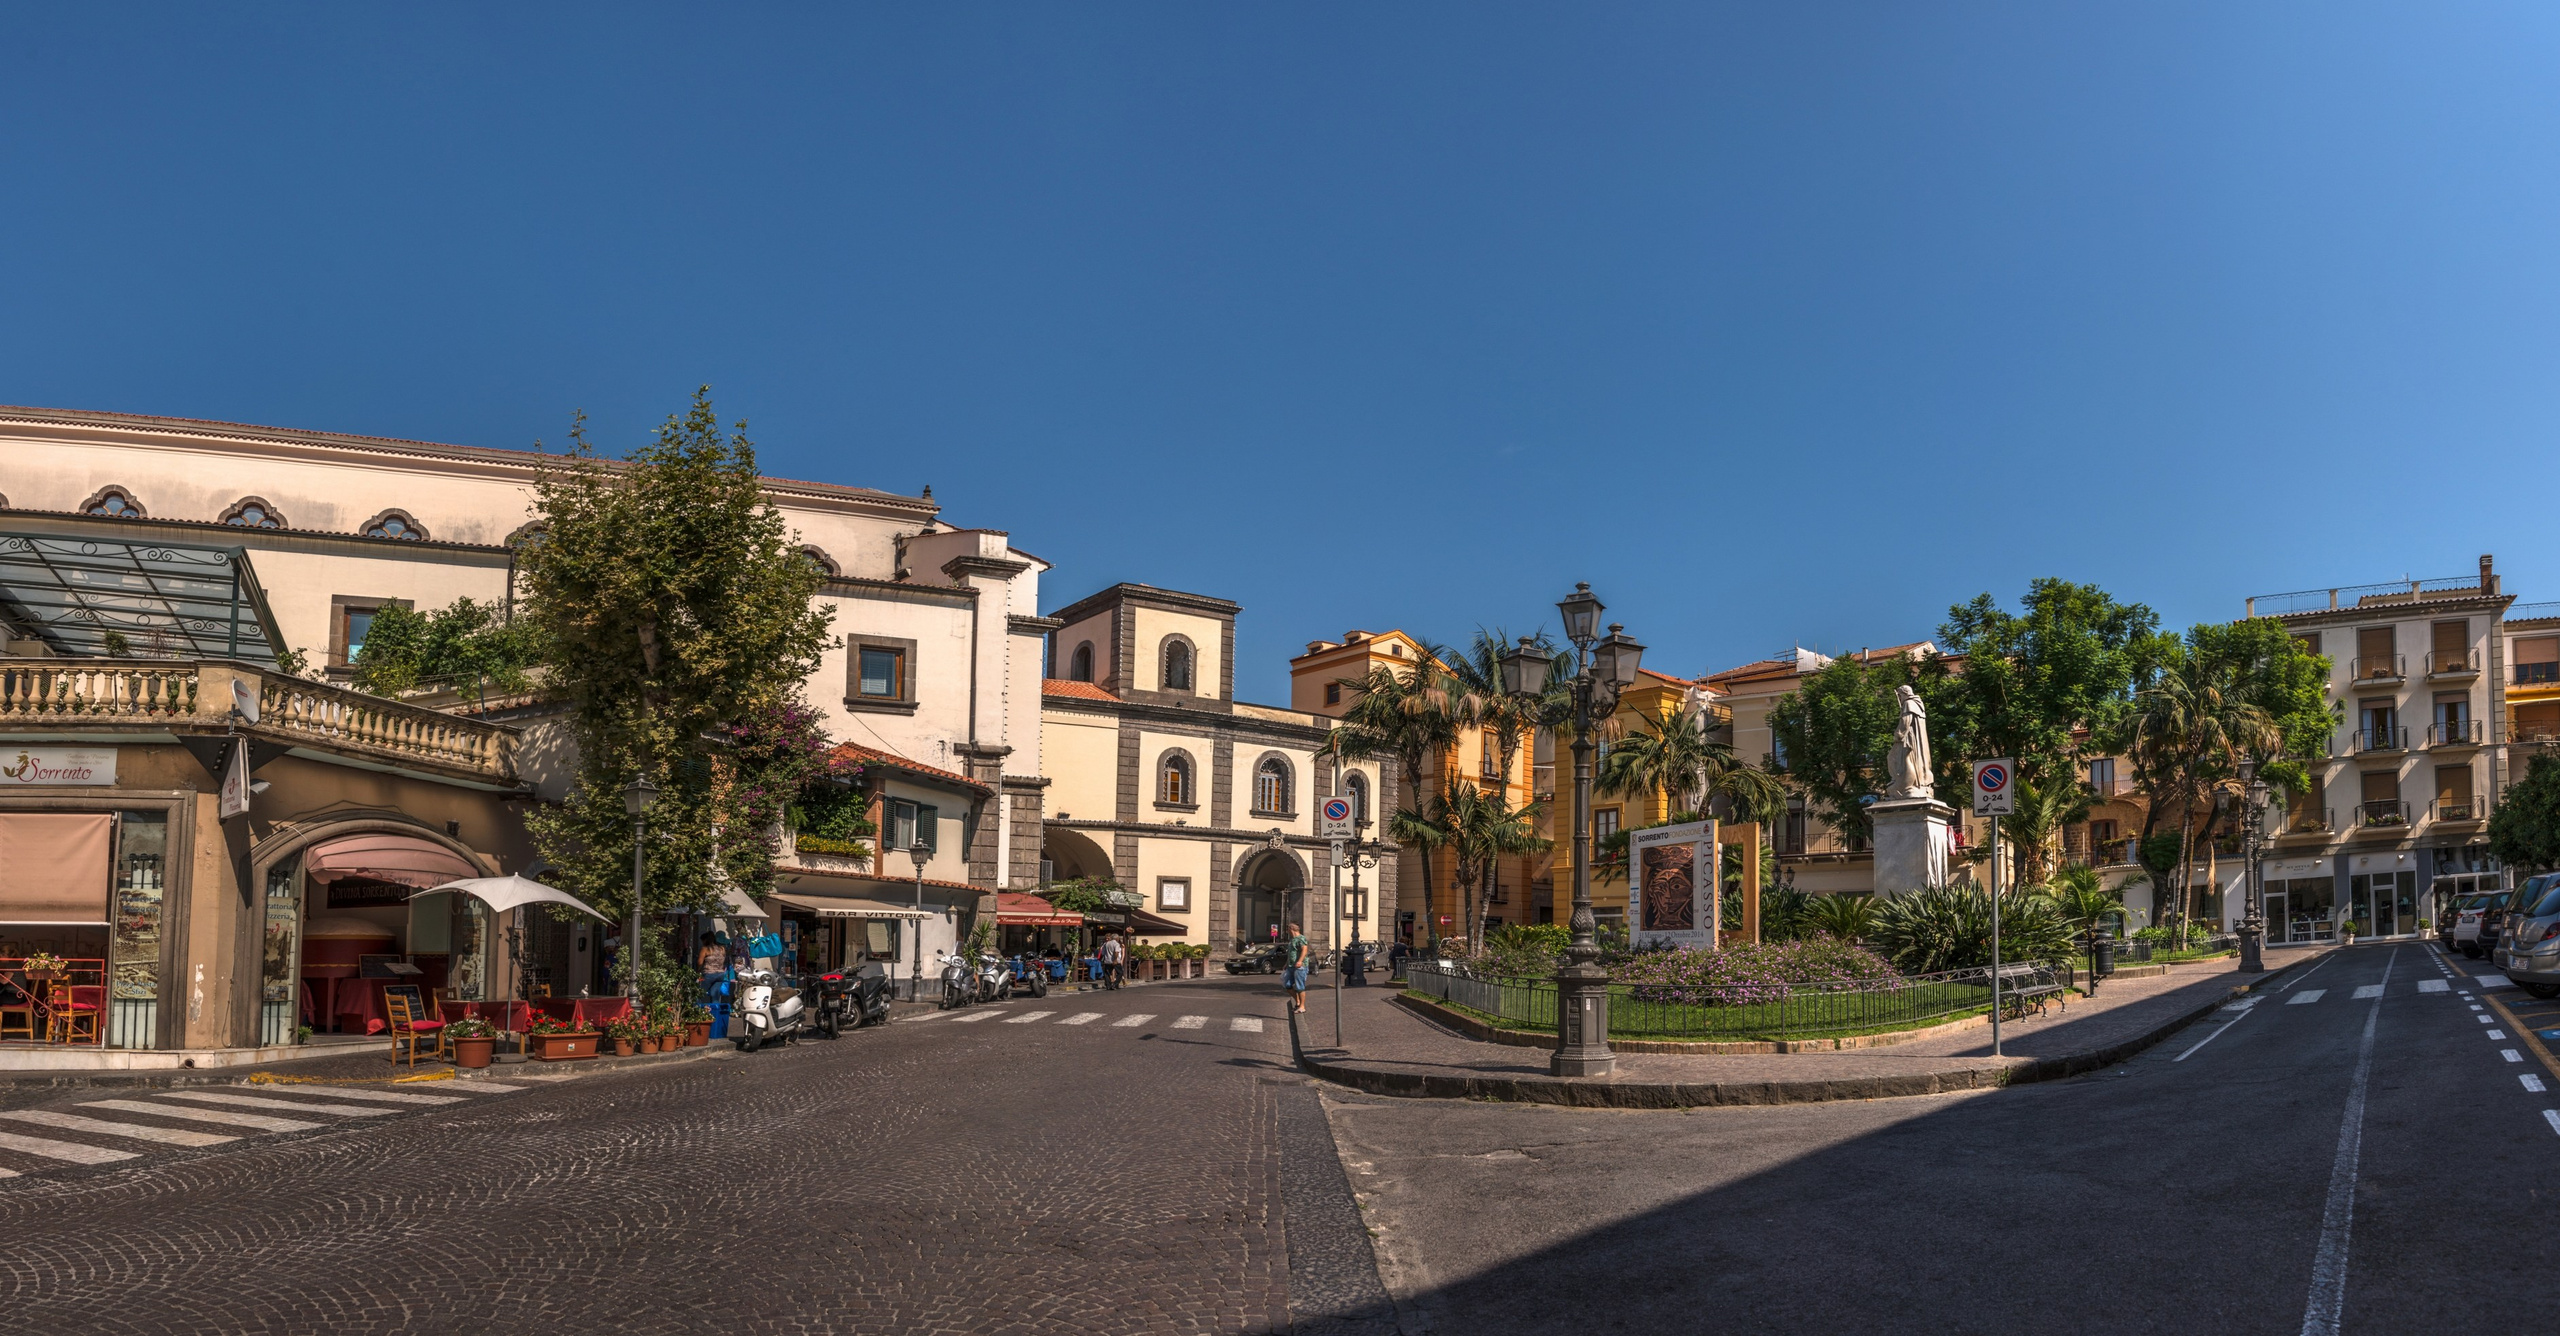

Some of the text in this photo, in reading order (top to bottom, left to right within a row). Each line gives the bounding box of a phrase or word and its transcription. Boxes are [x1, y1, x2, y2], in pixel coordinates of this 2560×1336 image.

[18, 758, 92, 782] Sorrento
[1983, 794, 2003, 802] 0-24
[1638, 827, 1702, 843] SORRENTO FONDAZIONE
[1703, 841, 1713, 930] PICASSO
[267, 912, 290, 920] izzeria
